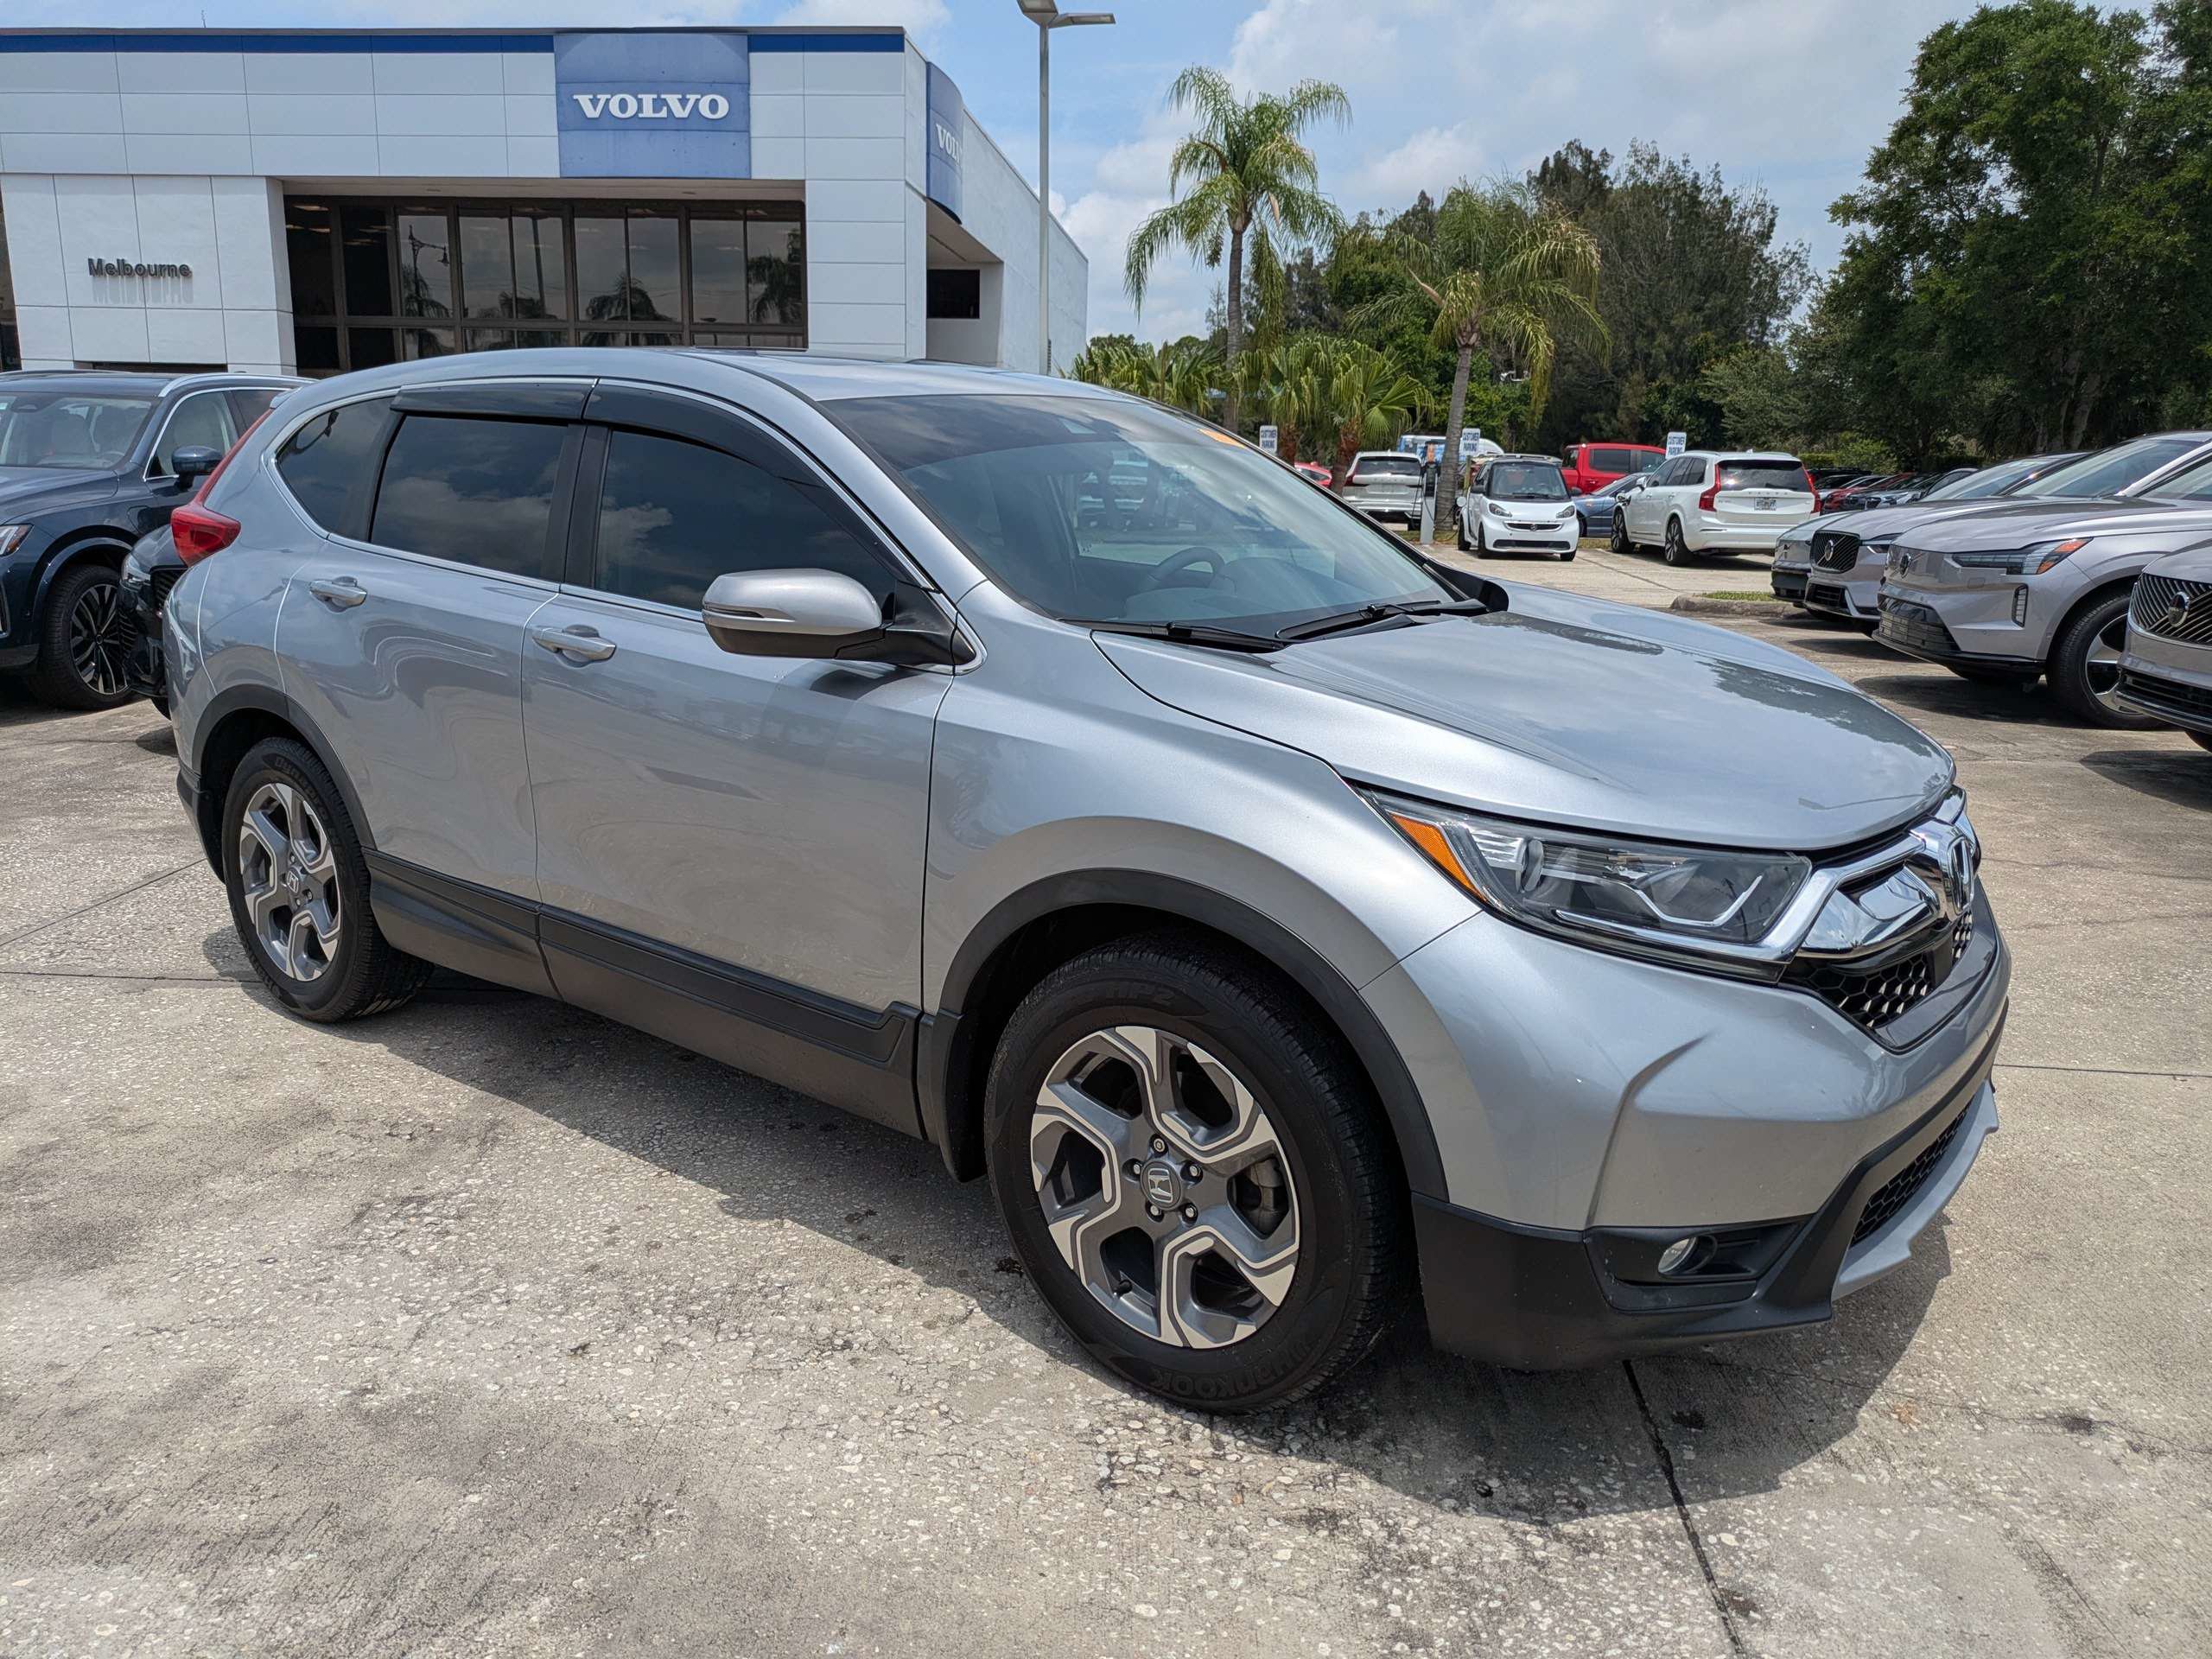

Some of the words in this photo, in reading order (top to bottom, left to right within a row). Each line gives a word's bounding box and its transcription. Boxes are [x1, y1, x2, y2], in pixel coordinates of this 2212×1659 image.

[573, 93, 730, 120] VOLVO
[87, 257, 193, 277] Melbourne
[1463, 432, 1479, 441] CUSTOMER
[1668, 435, 1685, 445] CUSTOMER
[1464, 442, 1478, 452] PARKING
